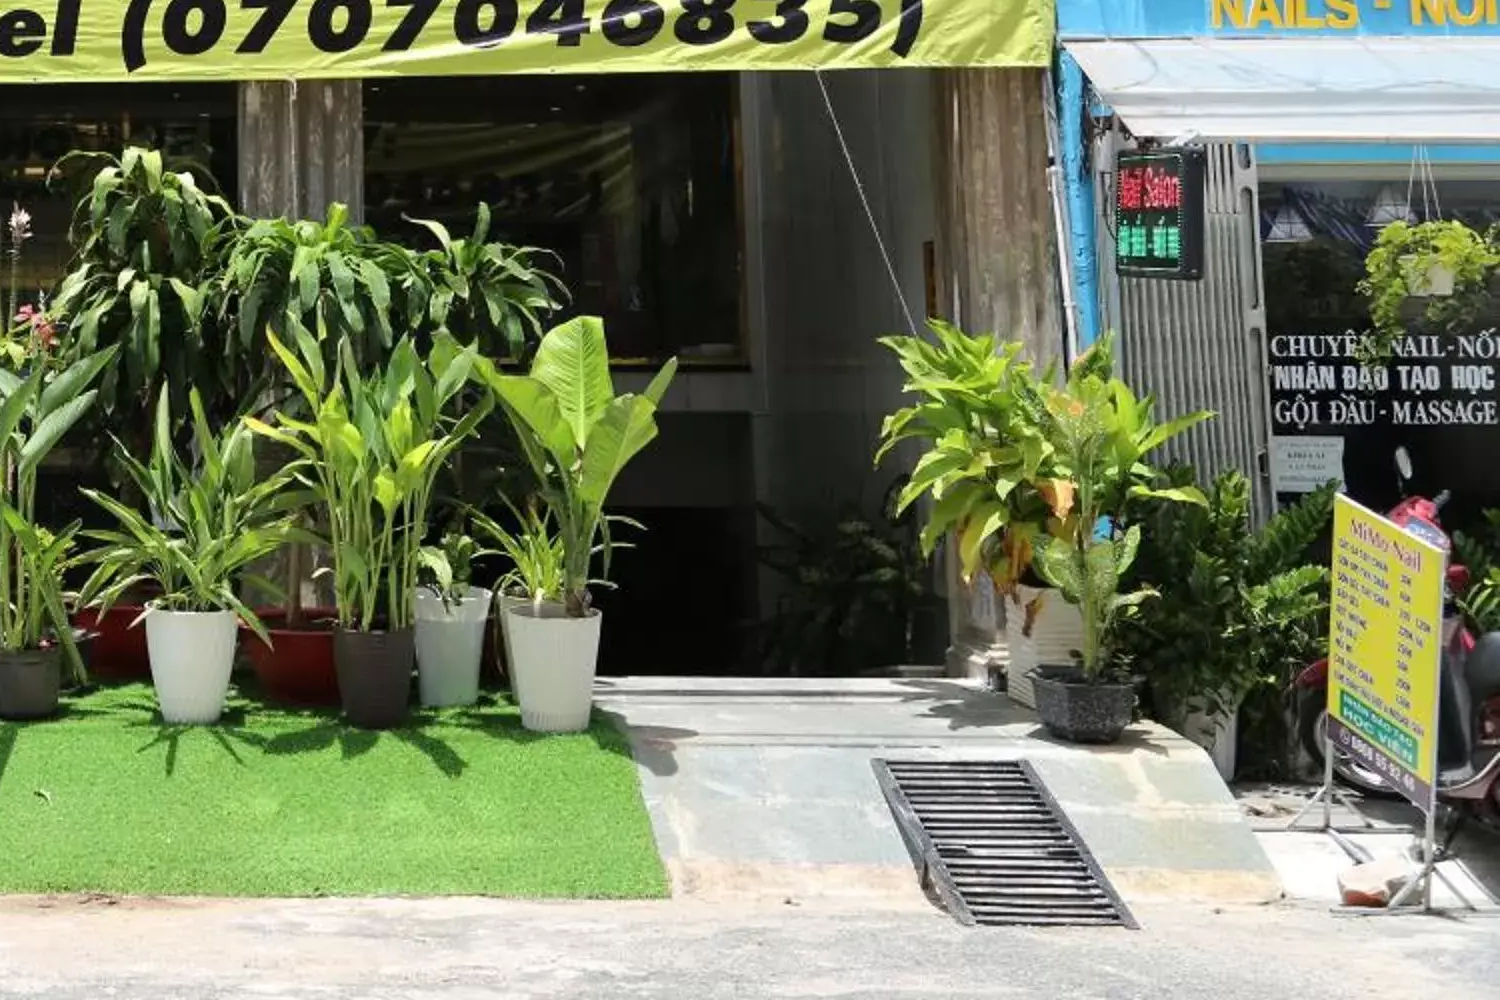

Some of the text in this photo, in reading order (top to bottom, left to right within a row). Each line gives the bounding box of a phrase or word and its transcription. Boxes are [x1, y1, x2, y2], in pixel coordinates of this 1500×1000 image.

[1274, 361, 1336, 394] NHẬN
[1397, 365, 1441, 395] TẠO
[1451, 365, 1496, 395] HỌC
[1274, 393, 1321, 430] GỘI
[1329, 392, 1375, 425] ĐẦU
[1392, 400, 1499, 425] MASSAGE
